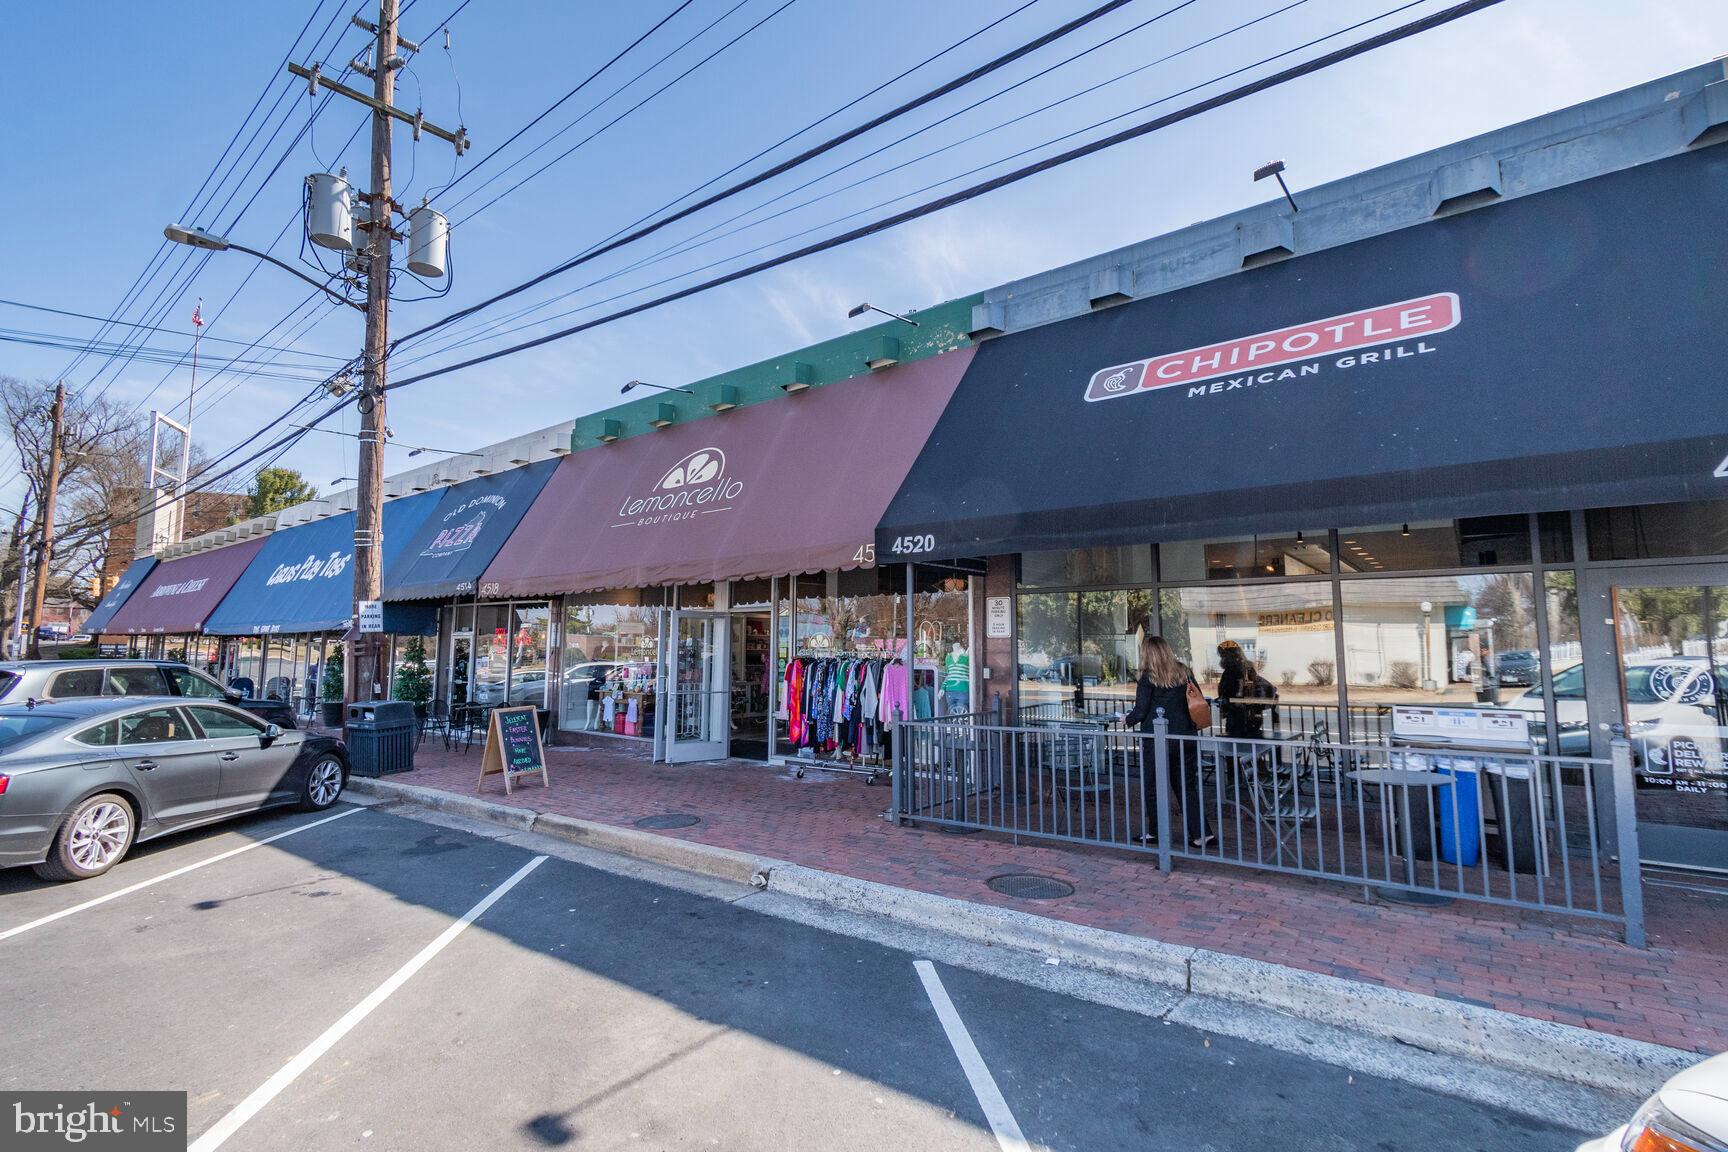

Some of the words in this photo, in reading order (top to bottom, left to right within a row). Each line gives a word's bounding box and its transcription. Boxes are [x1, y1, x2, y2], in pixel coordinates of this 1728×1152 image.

[1156, 306, 1432, 379] CHIPOTLE
[1188, 363, 1320, 398] MEXICAN
[1336, 342, 1436, 368] GRILL
[444, 504, 466, 522] OLD
[468, 494, 507, 510] DOMINION
[620, 476, 743, 516] Lemoncello
[637, 510, 698, 526] BOUTIQUE
[429, 522, 484, 550] PIZZA
[892, 534, 934, 554] 4520
[1644, 776, 1672, 785] 10:00
